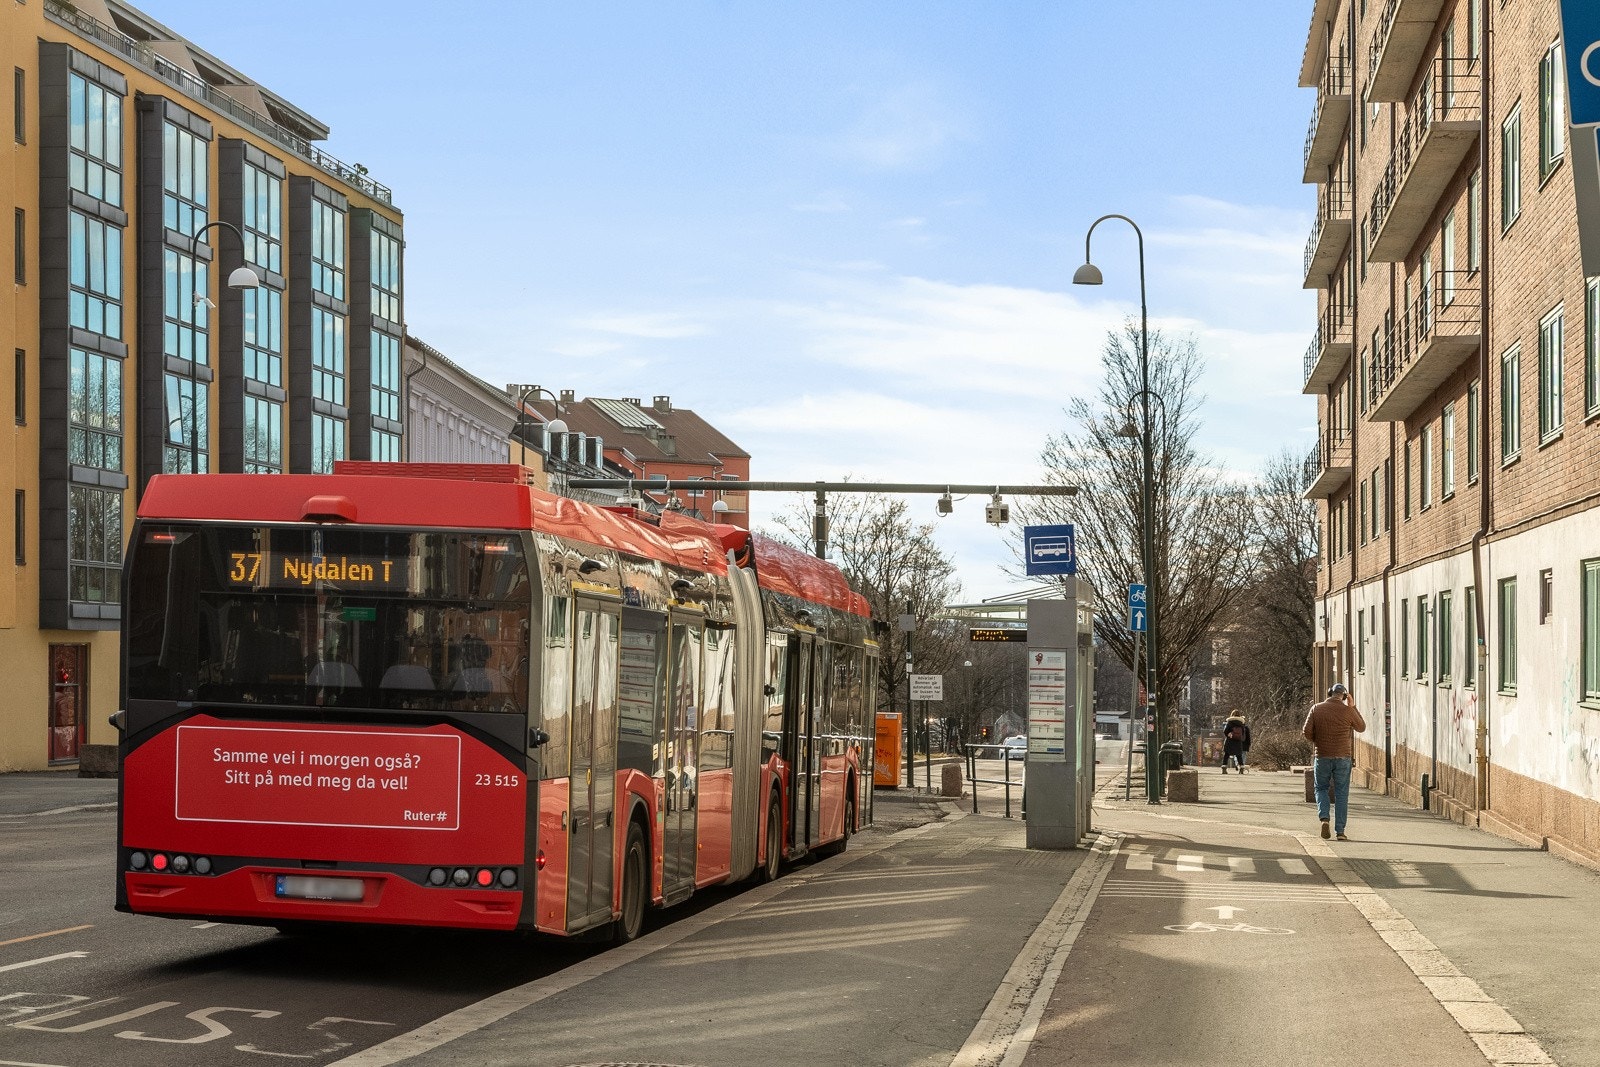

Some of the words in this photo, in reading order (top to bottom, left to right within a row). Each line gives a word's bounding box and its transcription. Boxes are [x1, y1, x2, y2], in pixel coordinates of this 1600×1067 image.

[231, 553, 262, 582] 37
[284, 556, 373, 584] Nydalen
[381, 561, 393, 582] T
[213, 748, 269, 765] Samme
[272, 750, 296, 765] vei
[299, 750, 305, 765] i
[309, 752, 370, 771] morgen
[374, 753, 421, 771] også?
[225, 769, 250, 785] Sitt
[254, 770, 274, 787] på
[278, 772, 312, 787] med
[317, 775, 351, 791] meg
[356, 774, 376, 790] da
[380, 775, 408, 791] vel!
[475, 773, 491, 786] 23
[494, 774, 519, 787] 515
[403, 809, 448, 822] Ruter#
